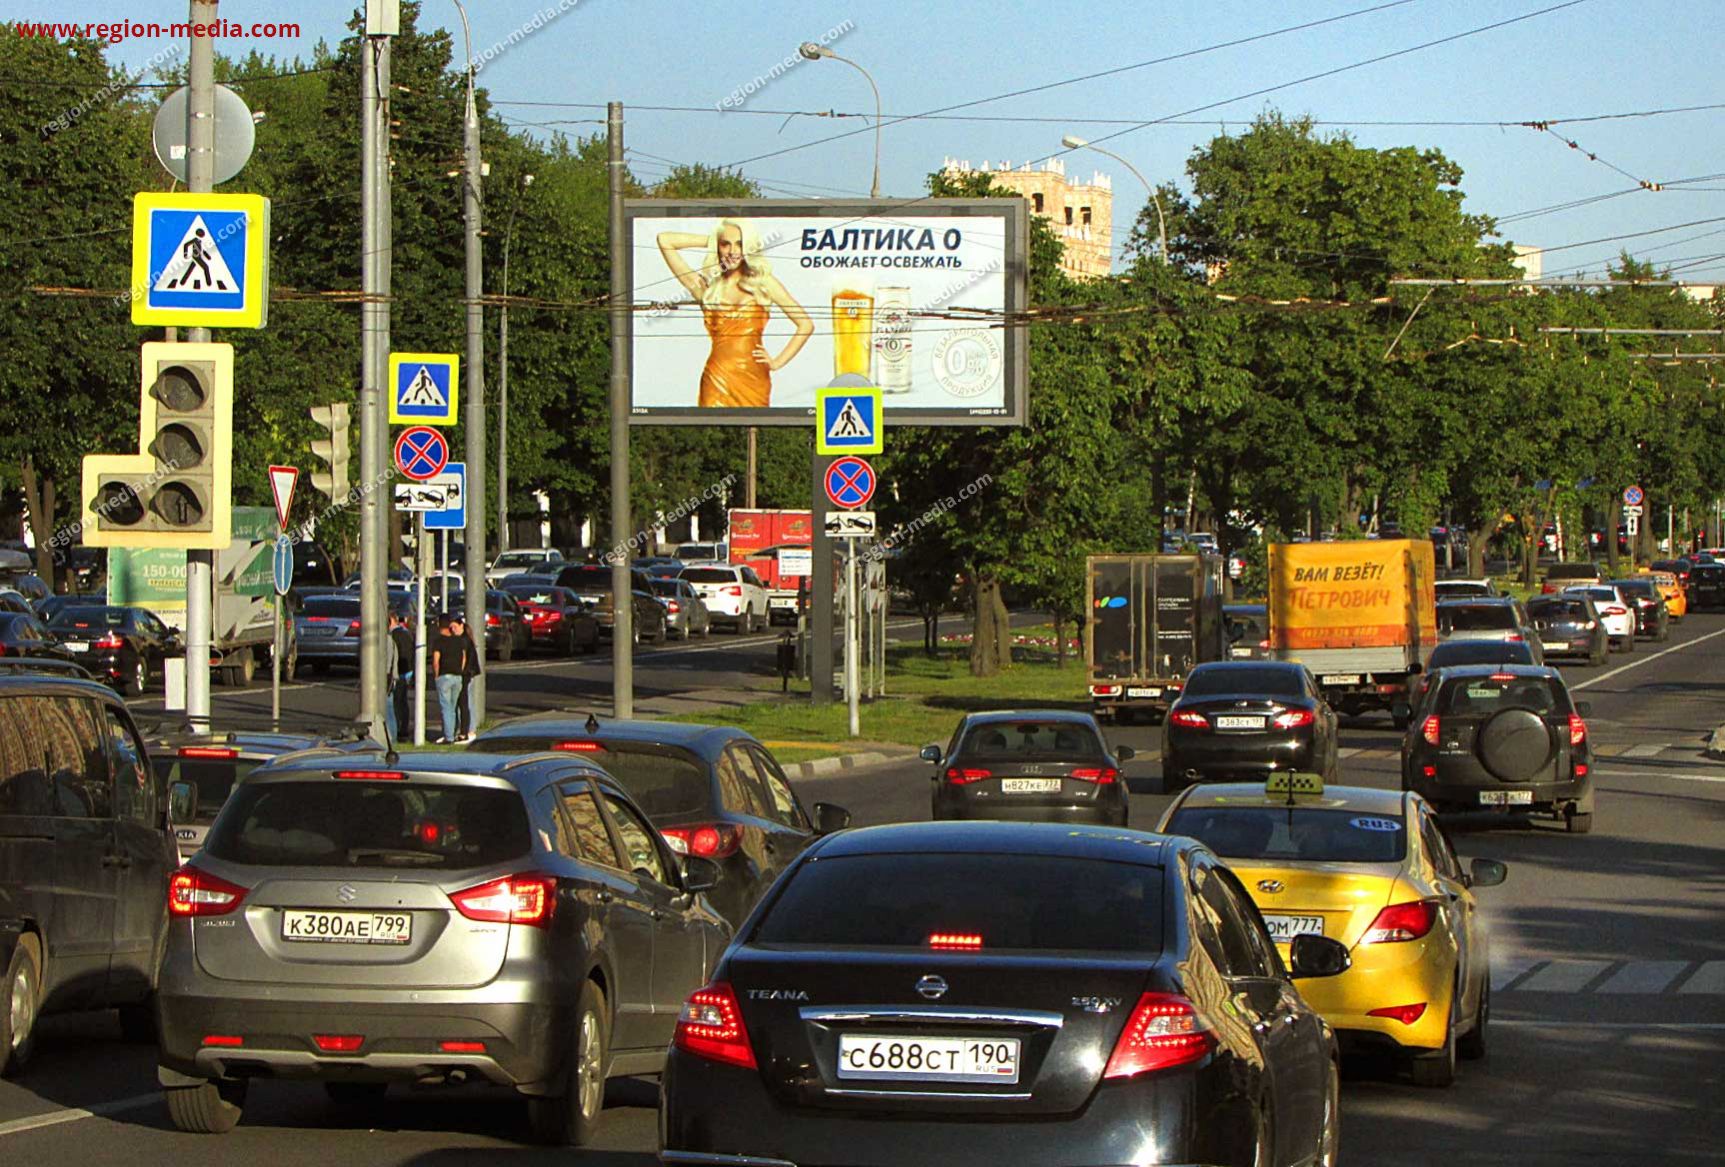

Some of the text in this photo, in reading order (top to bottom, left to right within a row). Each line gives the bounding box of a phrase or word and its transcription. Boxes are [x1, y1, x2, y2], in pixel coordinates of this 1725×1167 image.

[801, 228, 936, 251] БАЛТИКА
[800, 256, 962, 269] ОБОЖАЕТ ОСВЕЖАТЬ
[1294, 562, 1384, 582] ВАМ ВЕЗЁТ!
[1359, 819, 1396, 830] RUS
[178, 831, 196, 839] KIA
[290, 914, 405, 937] К380АЕ 799
[1292, 917, 1318, 931] 777
[747, 989, 809, 1000] TEANA
[850, 1042, 1009, 1070] С688СТ 190
